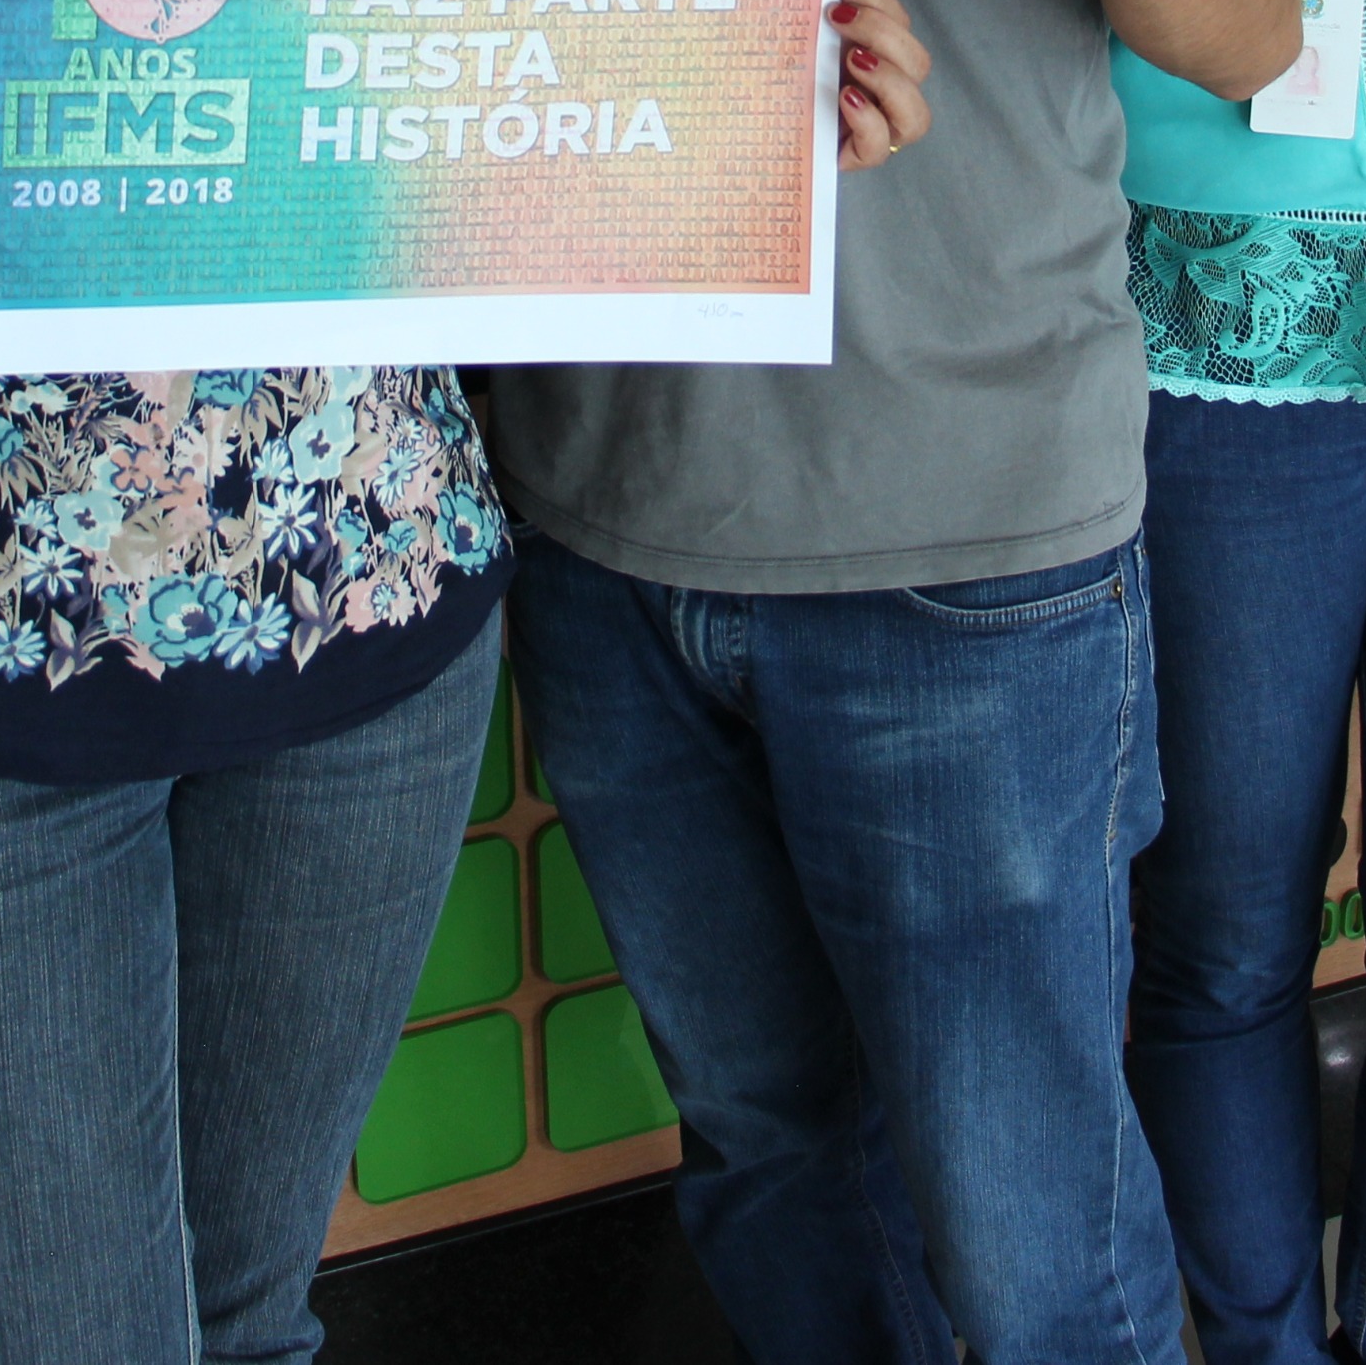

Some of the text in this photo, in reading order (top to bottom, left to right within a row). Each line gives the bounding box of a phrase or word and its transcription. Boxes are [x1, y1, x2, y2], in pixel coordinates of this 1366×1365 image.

[62, 46, 199, 81] ANOS
[304, 31, 561, 90] DESTA
[15, 89, 236, 156] IFMS
[300, 88, 673, 162] HISTÓRIA
[11, 178, 102, 209] 2008
[145, 176, 235, 206] 2018
